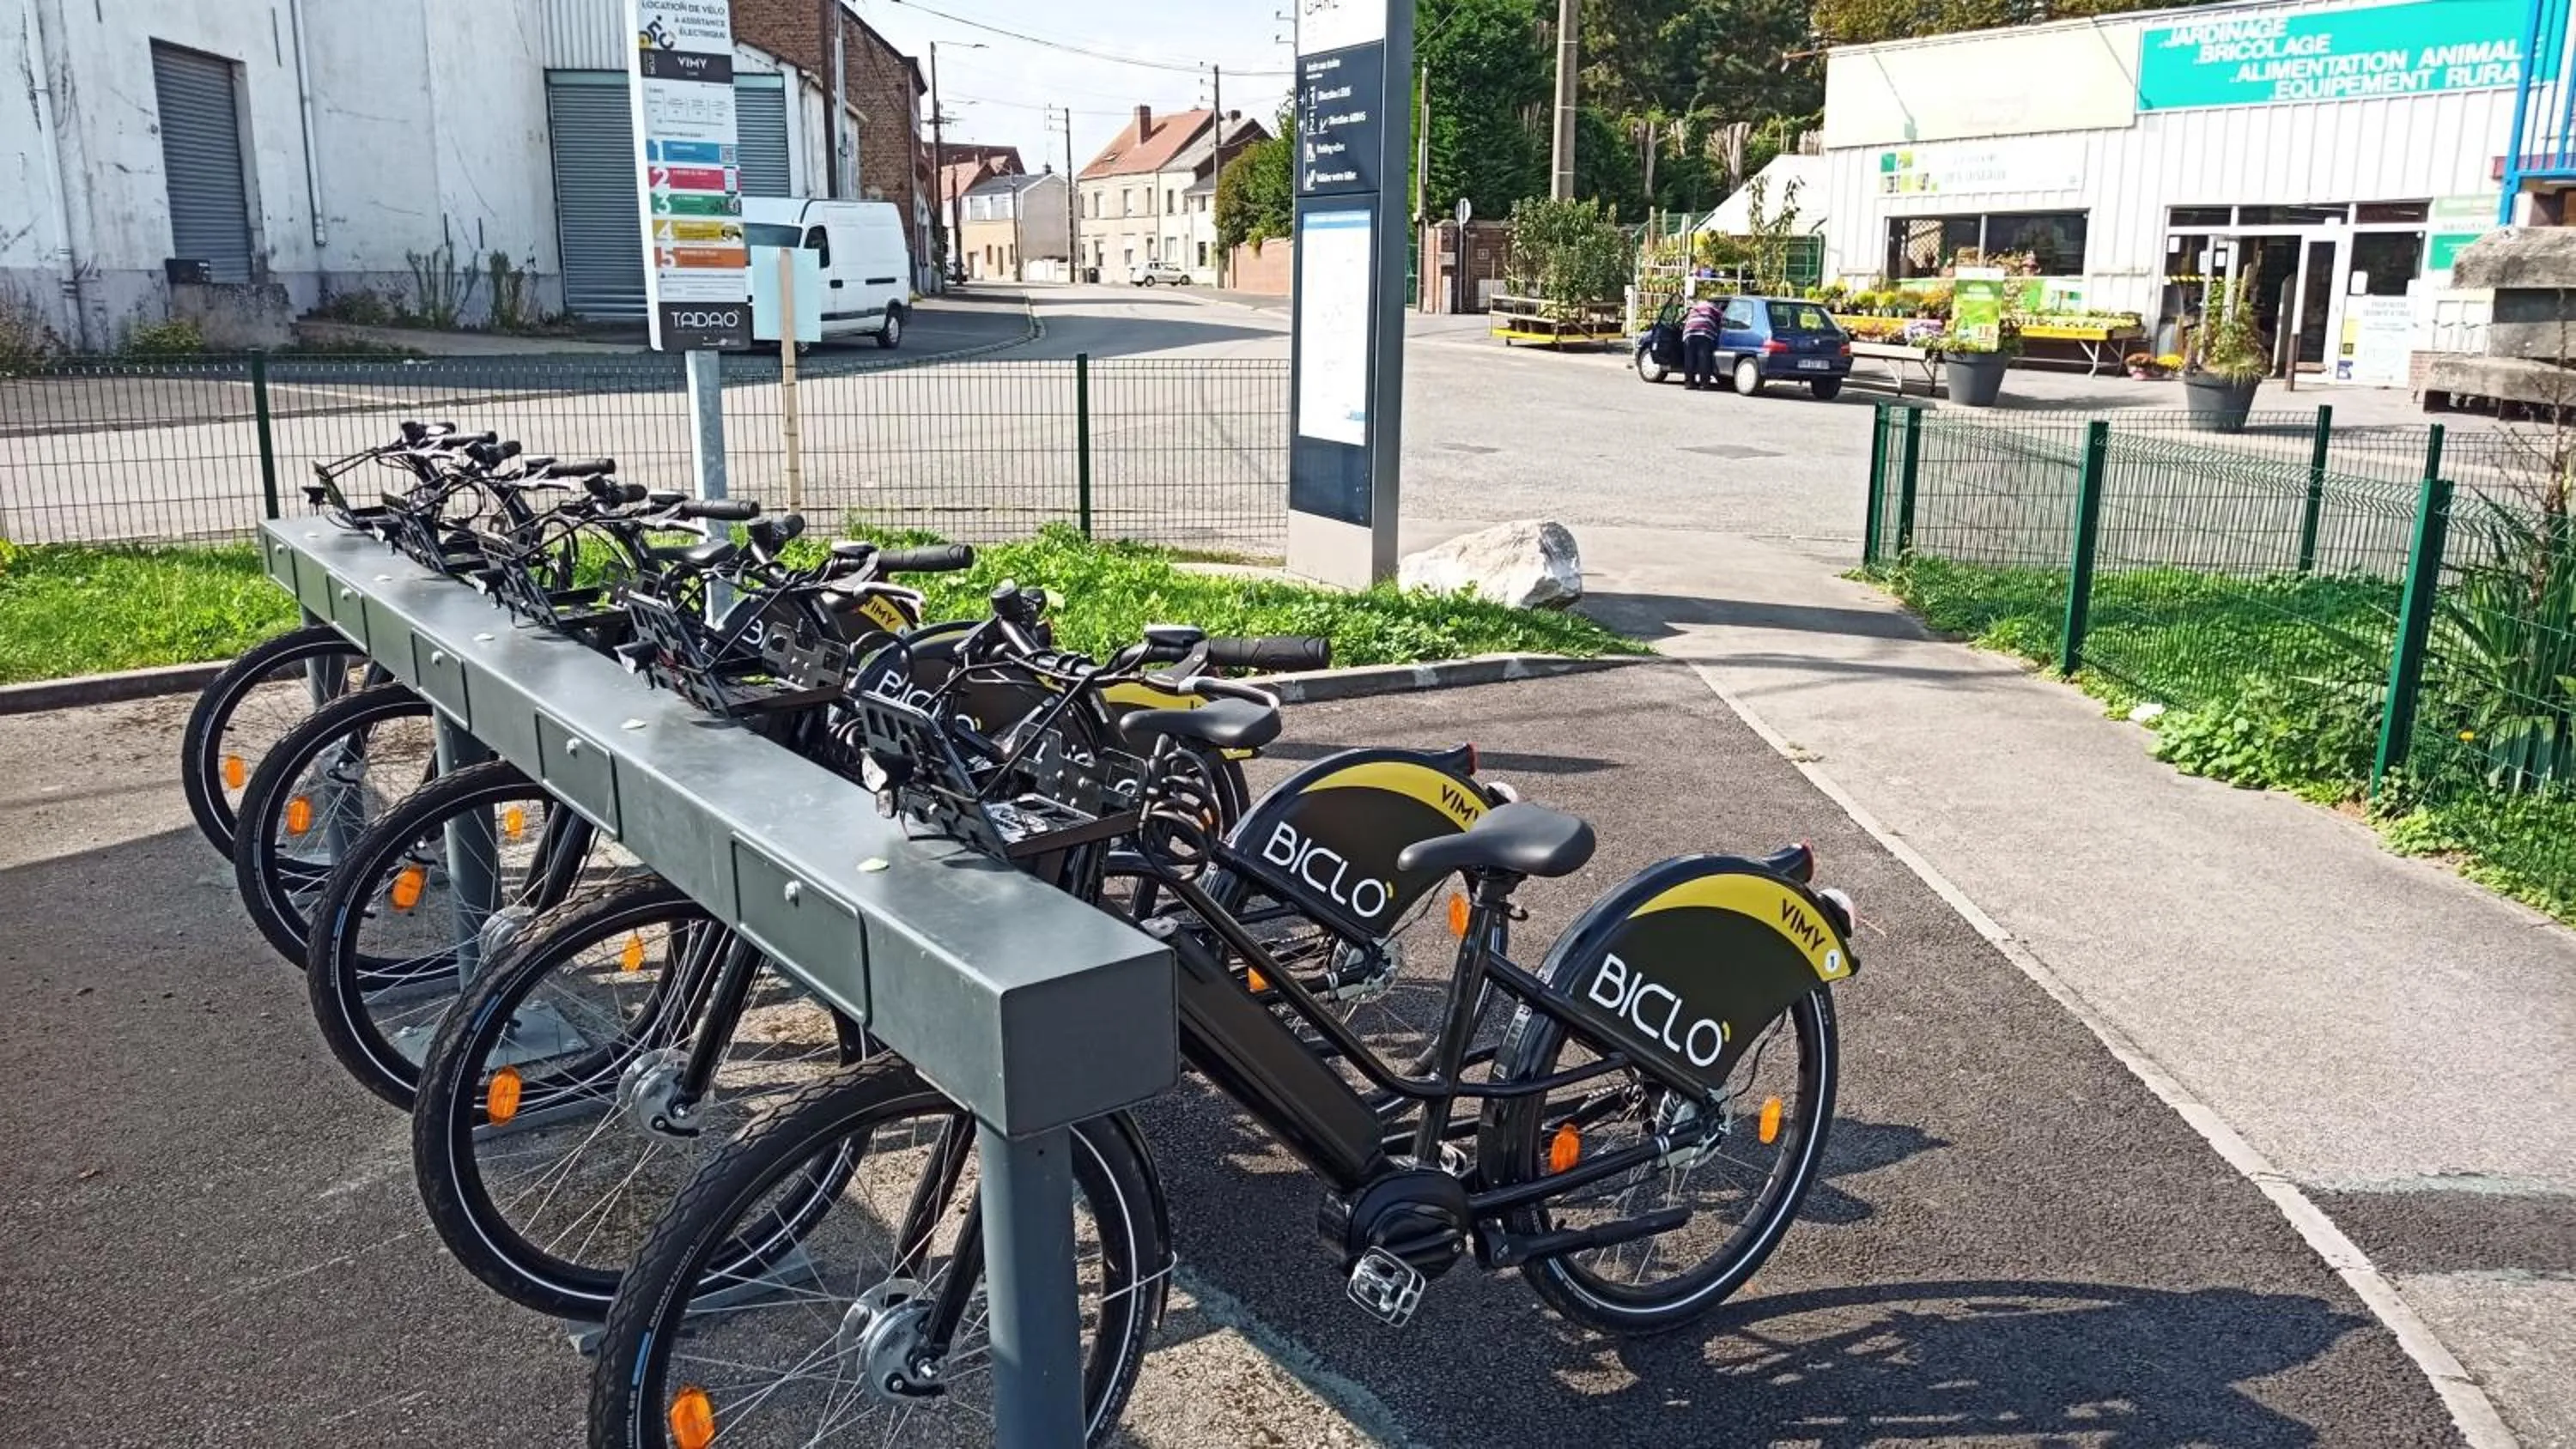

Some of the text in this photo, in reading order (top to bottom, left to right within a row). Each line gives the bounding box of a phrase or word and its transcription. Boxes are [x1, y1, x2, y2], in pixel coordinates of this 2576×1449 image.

[688, 4, 699, 14] DE
[677, 56, 708, 70] VIMY
[652, 167, 670, 189] 2
[656, 191, 671, 214] 3
[656, 219, 674, 241] 4
[660, 246, 677, 268] 5
[1779, 898, 1826, 952] VIMY
